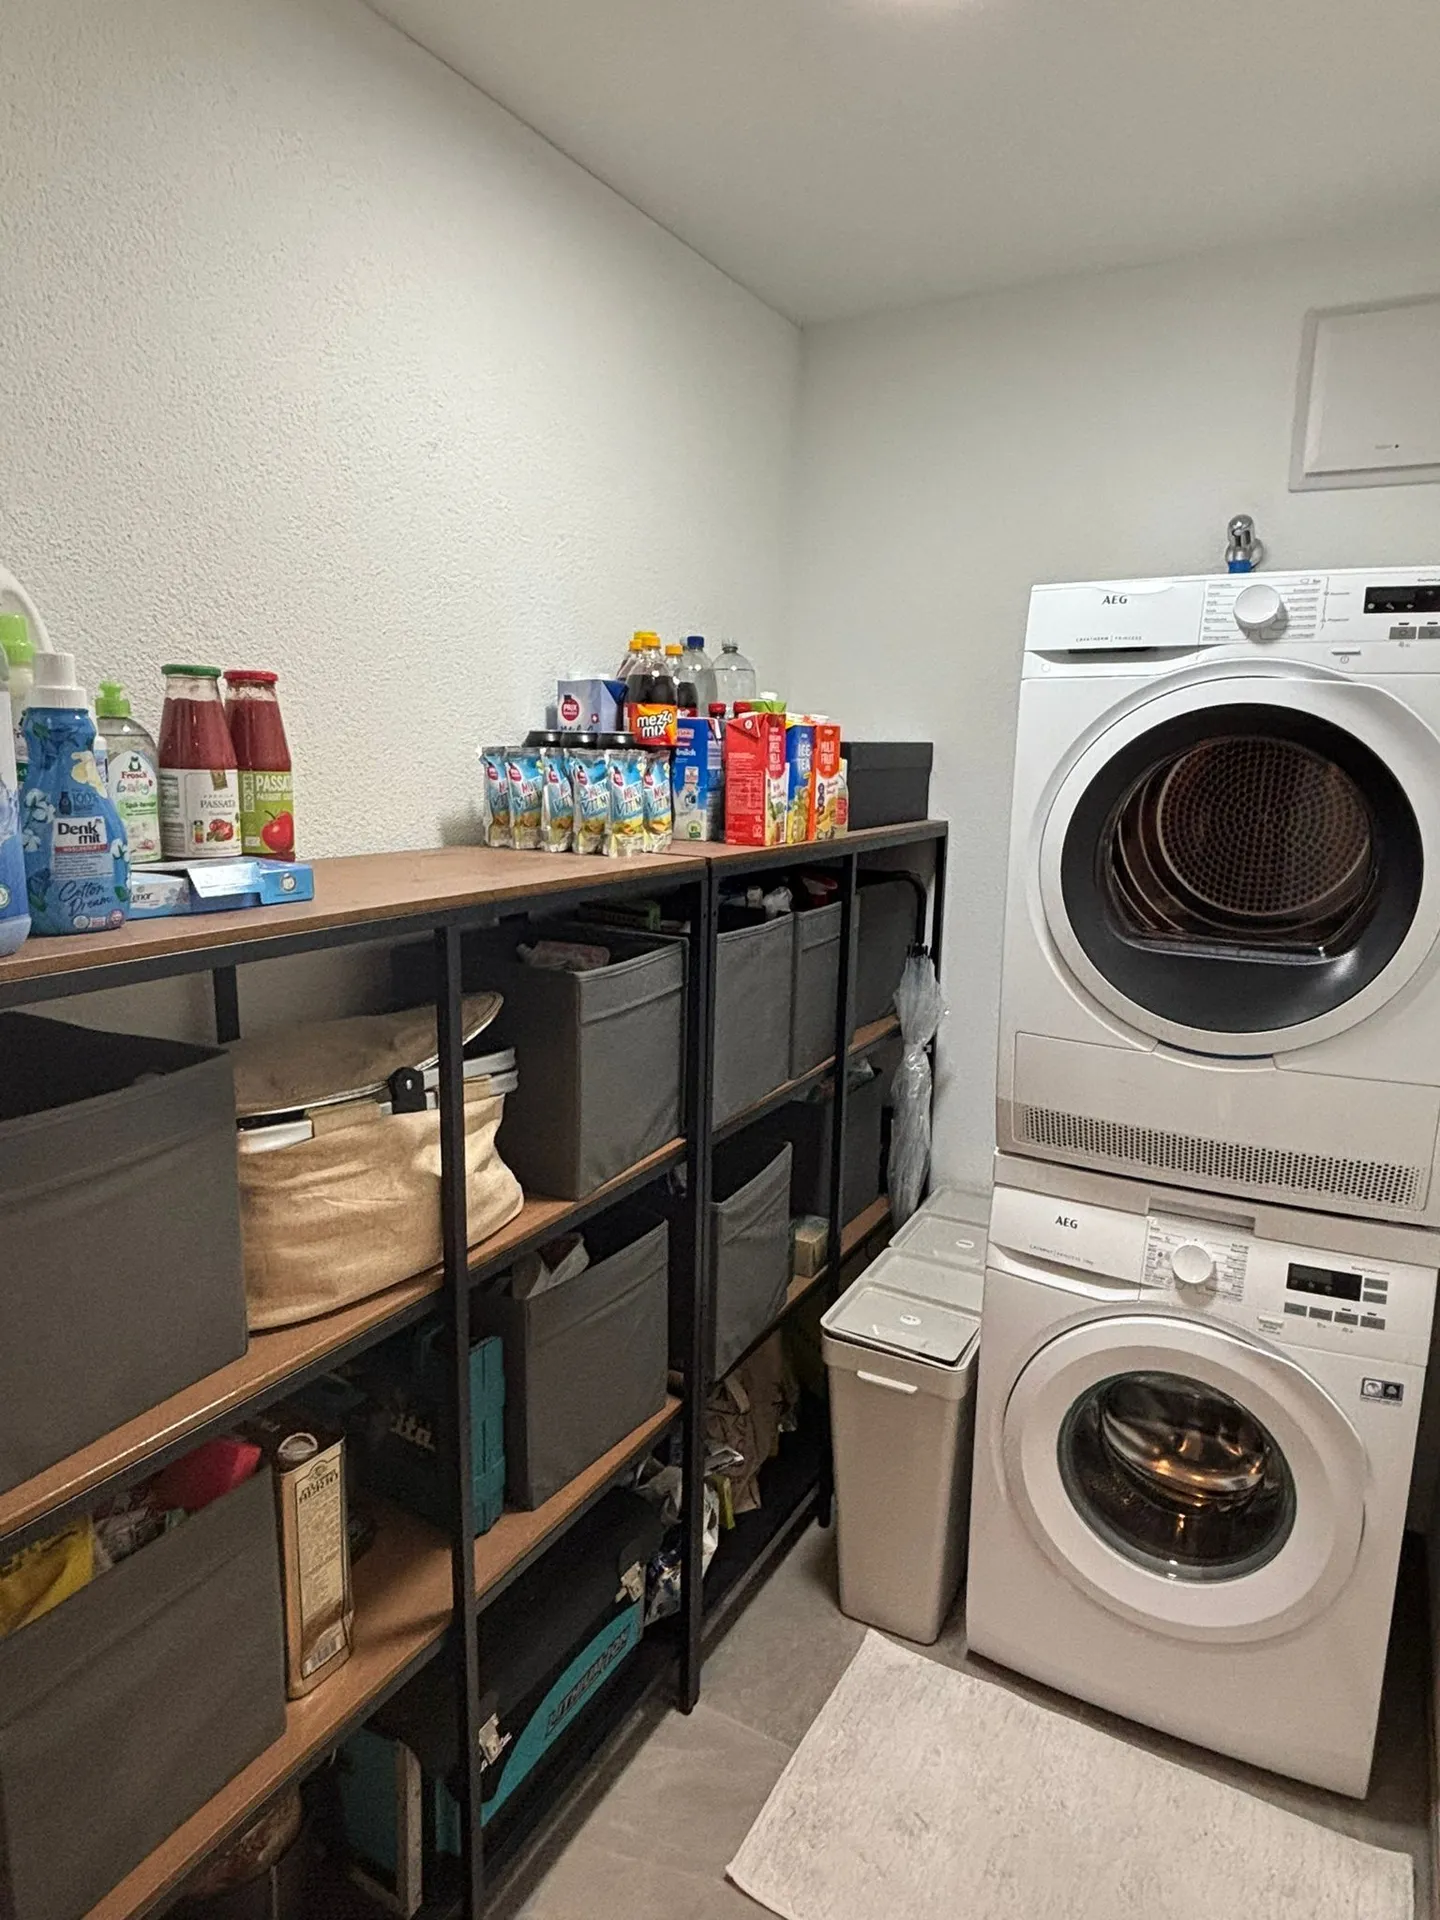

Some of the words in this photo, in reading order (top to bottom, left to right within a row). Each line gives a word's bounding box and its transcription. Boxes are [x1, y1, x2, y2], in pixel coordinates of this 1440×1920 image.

[1102, 595, 1128, 605] AEG
[637, 709, 673, 728] mezzo
[642, 723, 667, 738] mix
[797, 743, 812, 757] ICE
[797, 757, 811, 771] TEA
[121, 771, 147, 779] Frosch
[58, 821, 99, 836] Denk
[79, 834, 101, 845] mit
[59, 880, 105, 902] Cotton
[1055, 1215, 1078, 1230] AEG
